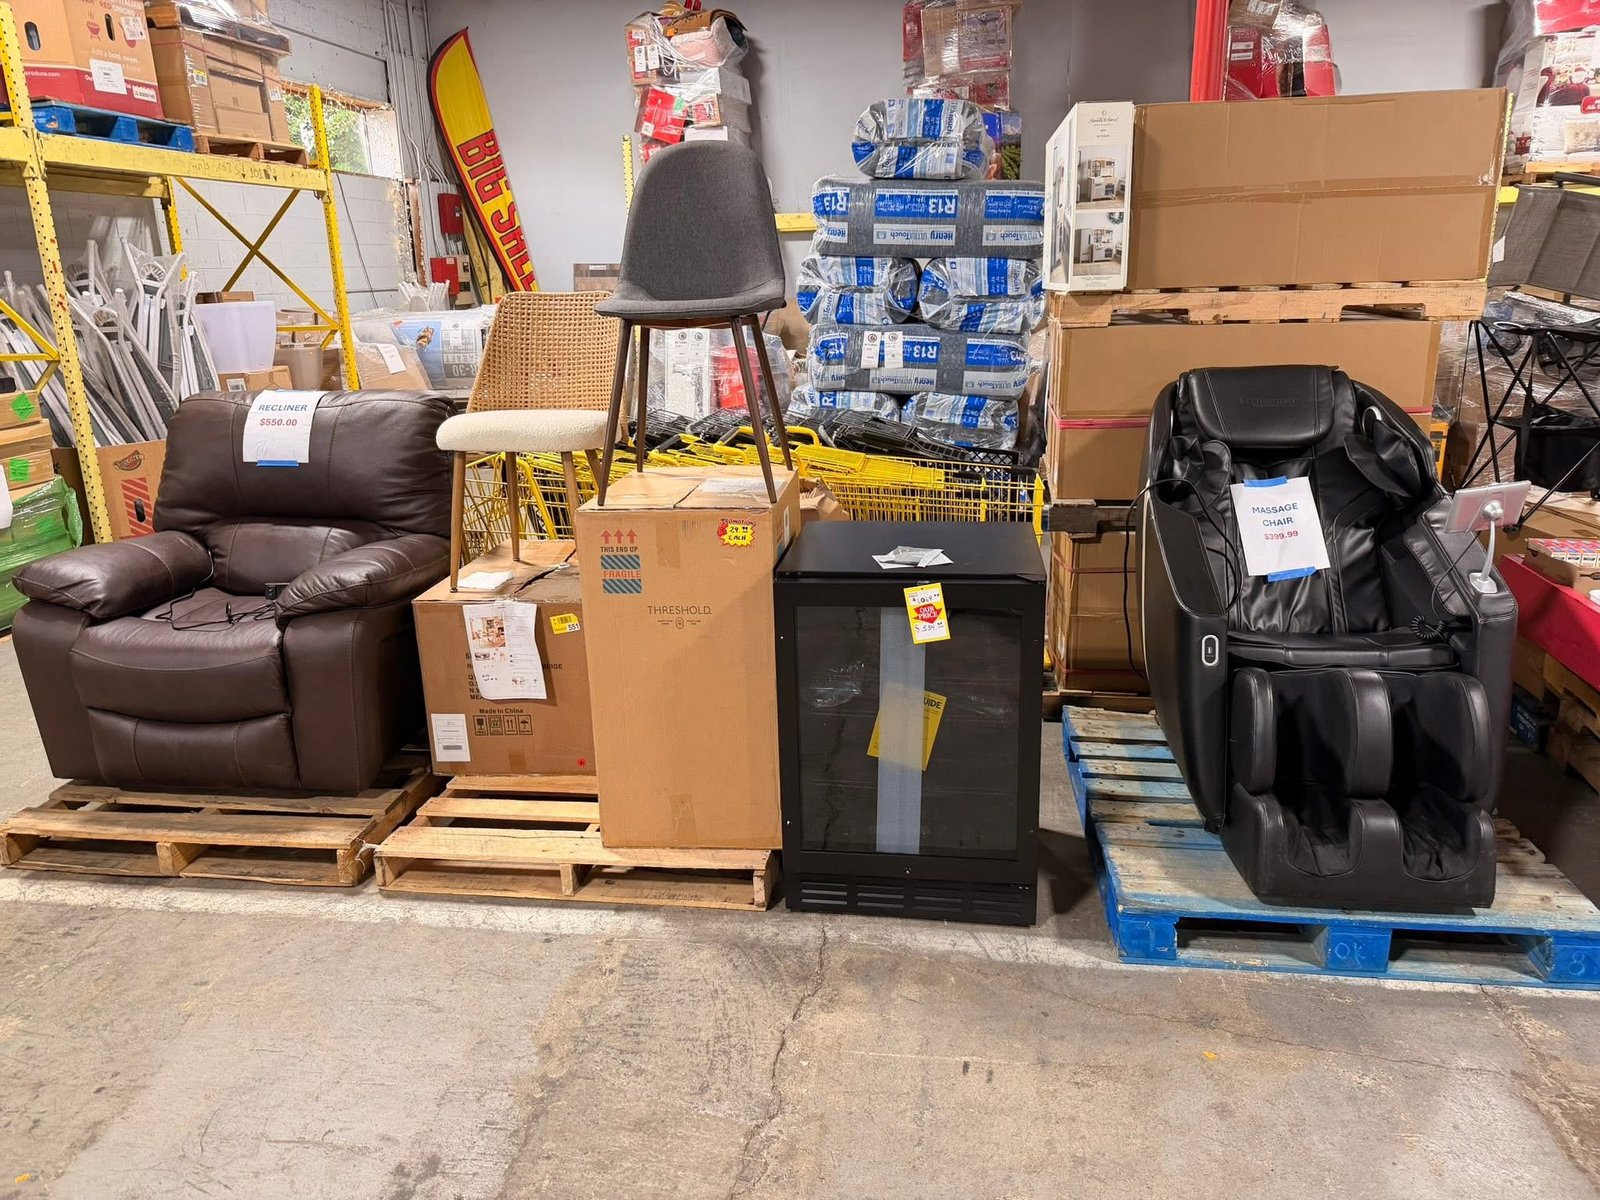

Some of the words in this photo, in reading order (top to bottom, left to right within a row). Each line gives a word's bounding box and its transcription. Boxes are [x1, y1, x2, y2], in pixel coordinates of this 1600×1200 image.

[456, 128, 511, 204] BIG
[823, 196, 847, 212] R13
[928, 198, 956, 214] R13
[930, 230, 953, 241] Henry
[913, 345, 938, 359] R13
[914, 377, 935, 386] Henry
[258, 404, 308, 412] RECLINER
[259, 418, 298, 427] $550.00
[1251, 502, 1299, 514] MASSAGE
[1262, 516, 1294, 527] CHAIR
[1263, 530, 1299, 541] $399.99
[603, 570, 642, 578] FRAGILE
[923, 696, 943, 710] UIDE
